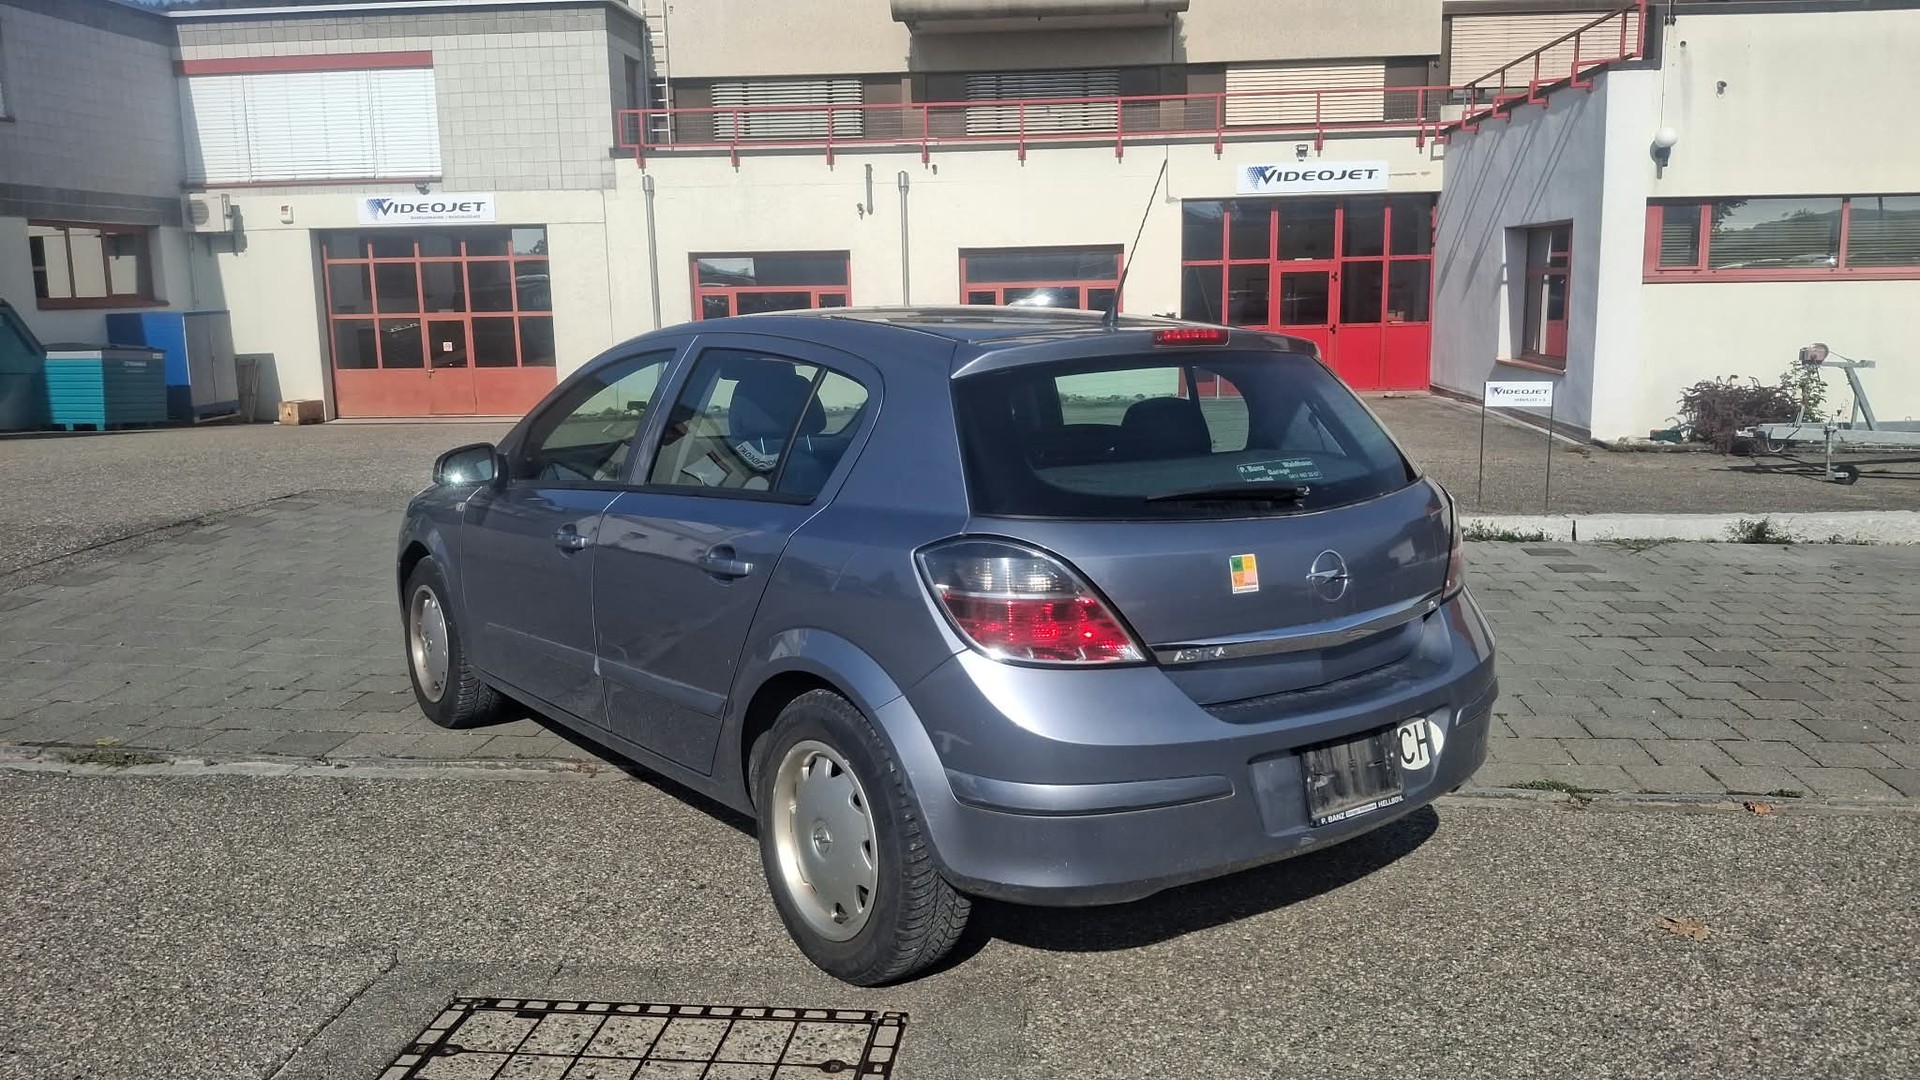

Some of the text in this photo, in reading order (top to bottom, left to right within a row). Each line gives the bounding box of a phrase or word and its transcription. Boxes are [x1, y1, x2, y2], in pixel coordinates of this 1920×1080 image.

[1260, 168, 1379, 185] VIDEOJET
[377, 199, 486, 216] VIDEOJET
[1494, 387, 1548, 395] VIDEOJET
[1173, 646, 1228, 661] ASTRA
[1400, 721, 1431, 764] CH
[1321, 817, 1328, 825] P.
[1327, 812, 1346, 823] BANZ
